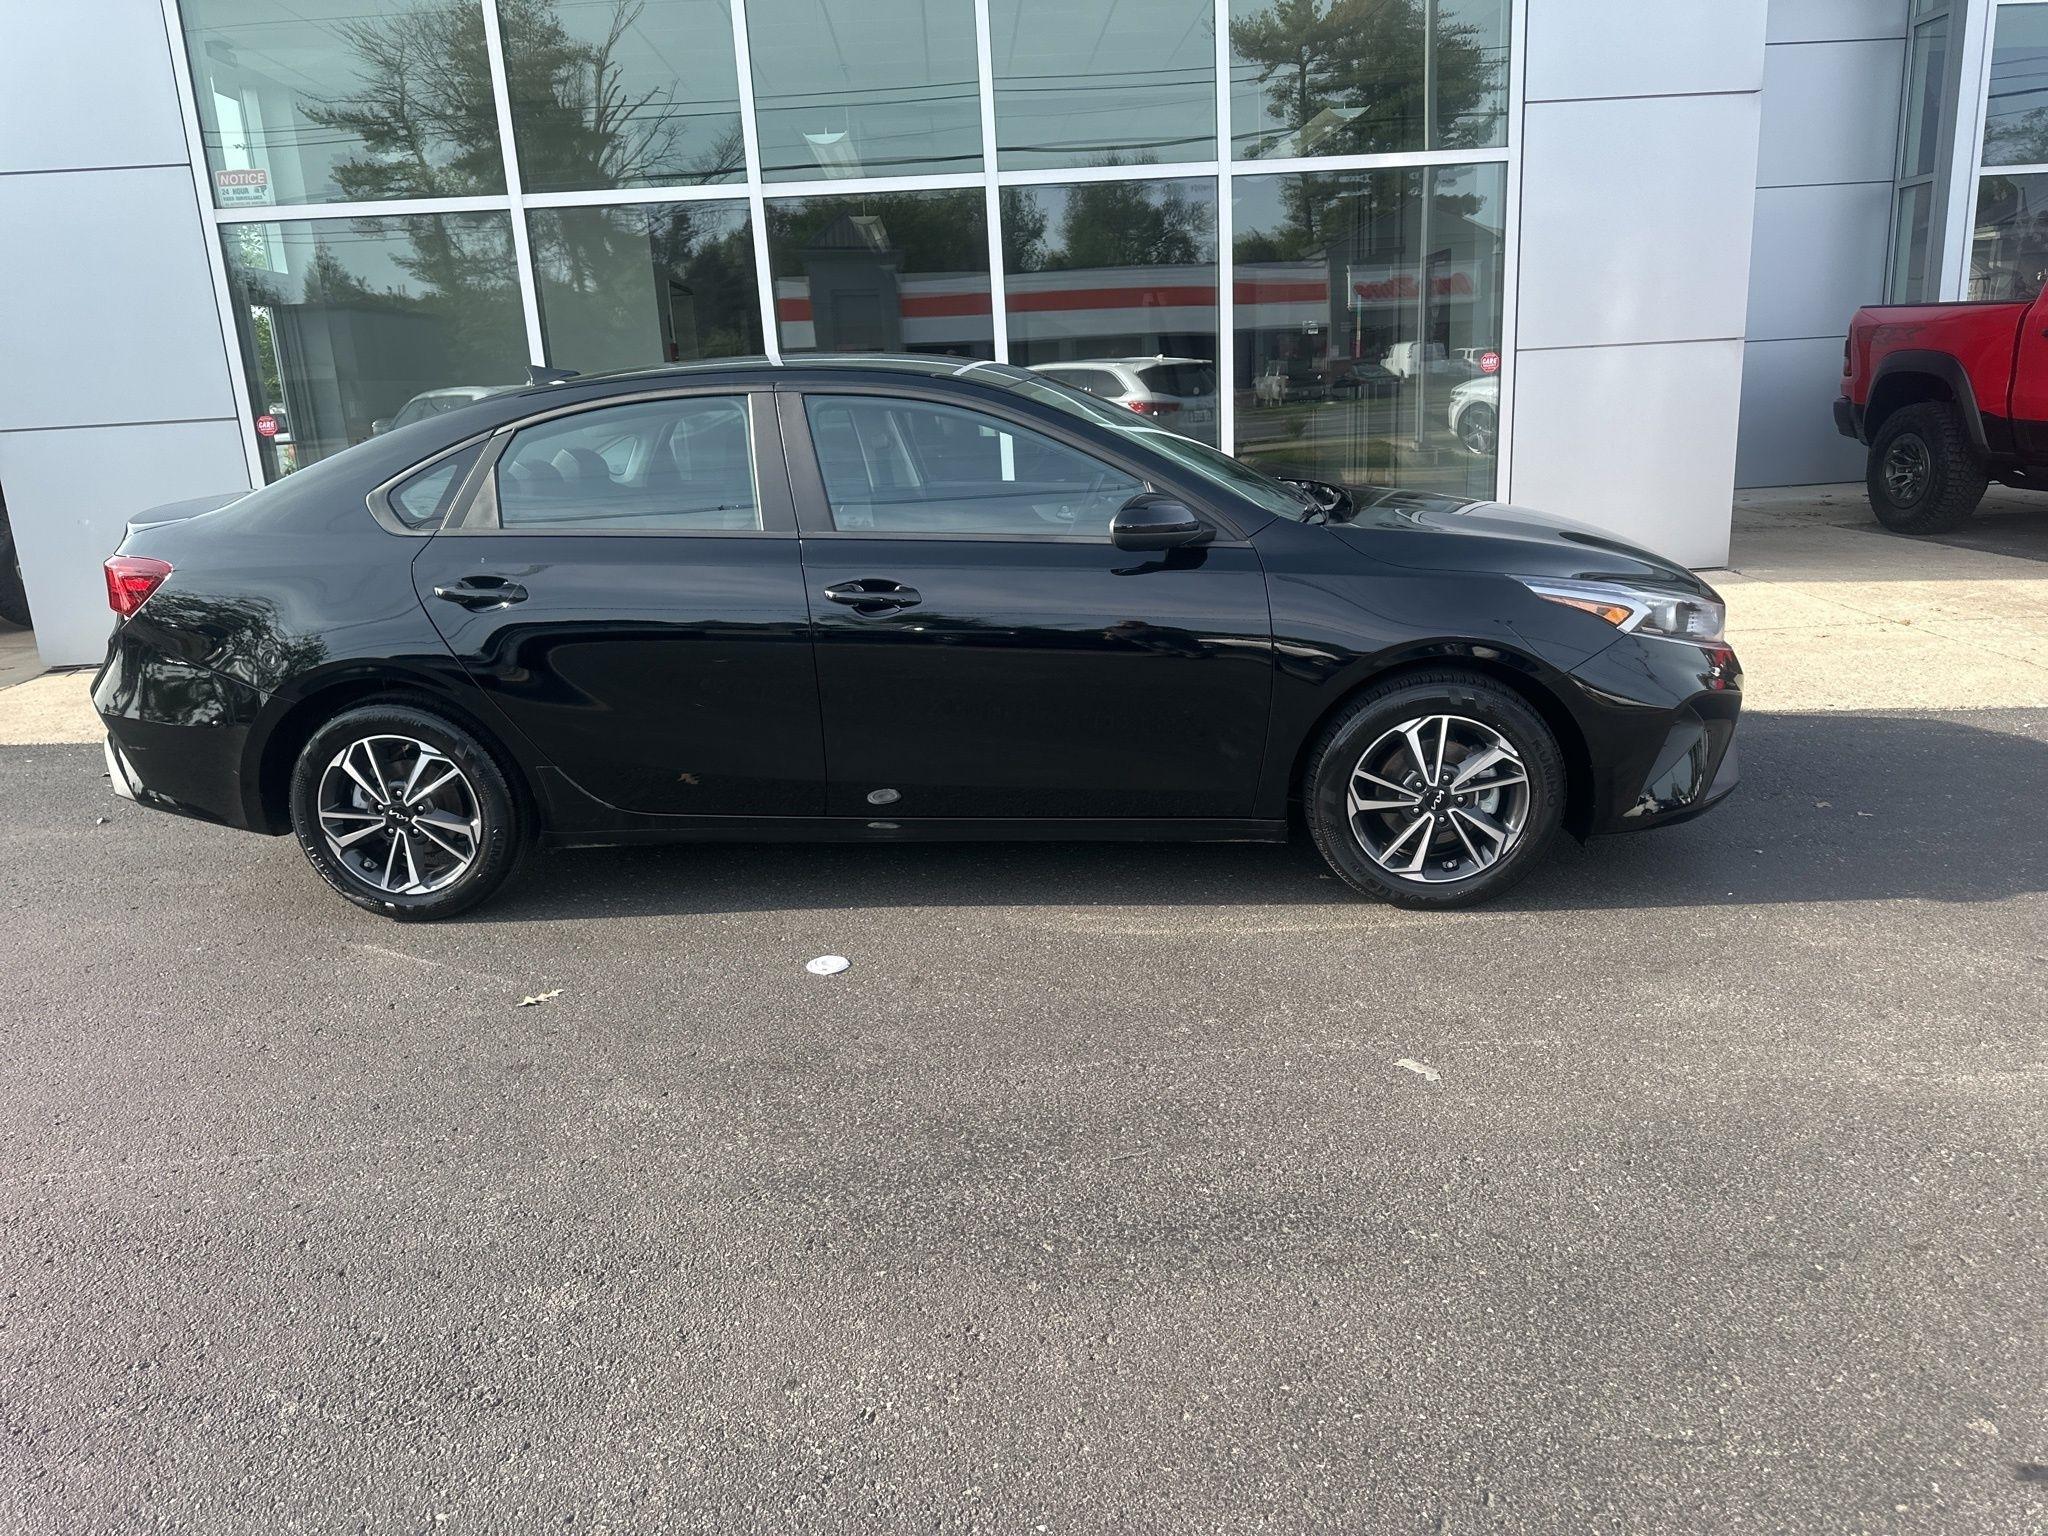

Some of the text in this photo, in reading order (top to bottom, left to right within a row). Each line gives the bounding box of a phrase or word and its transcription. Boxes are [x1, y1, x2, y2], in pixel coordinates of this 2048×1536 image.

[220, 172, 265, 185] NOTICE
[232, 187, 249, 195] HOUR
[258, 420, 275, 429] CARE
